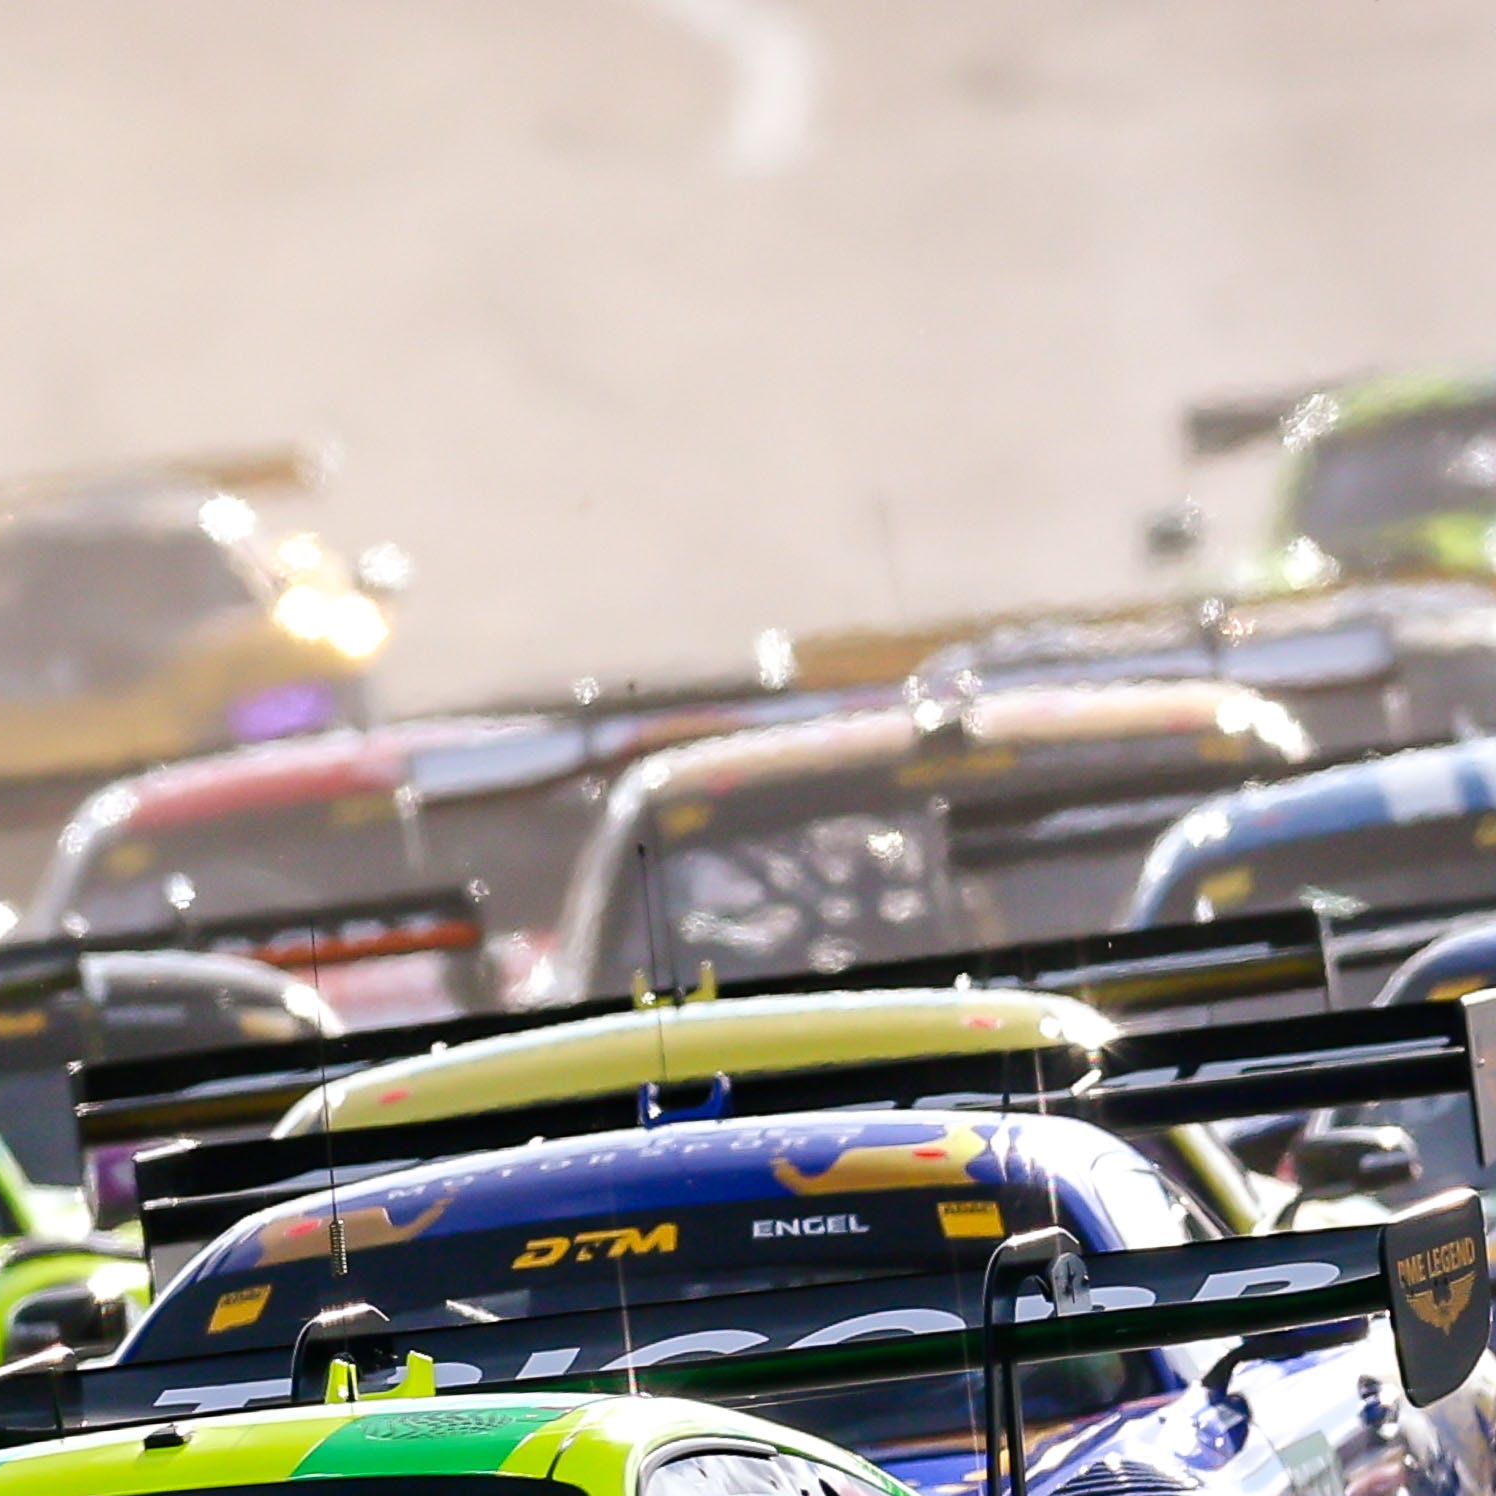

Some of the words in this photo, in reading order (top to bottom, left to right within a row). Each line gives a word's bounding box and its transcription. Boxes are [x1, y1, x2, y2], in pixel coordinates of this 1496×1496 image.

[512, 1222, 679, 1271] DTM
[752, 1214, 870, 1238] ENGEL
[1426, 1236, 1476, 1280] LEGEND
